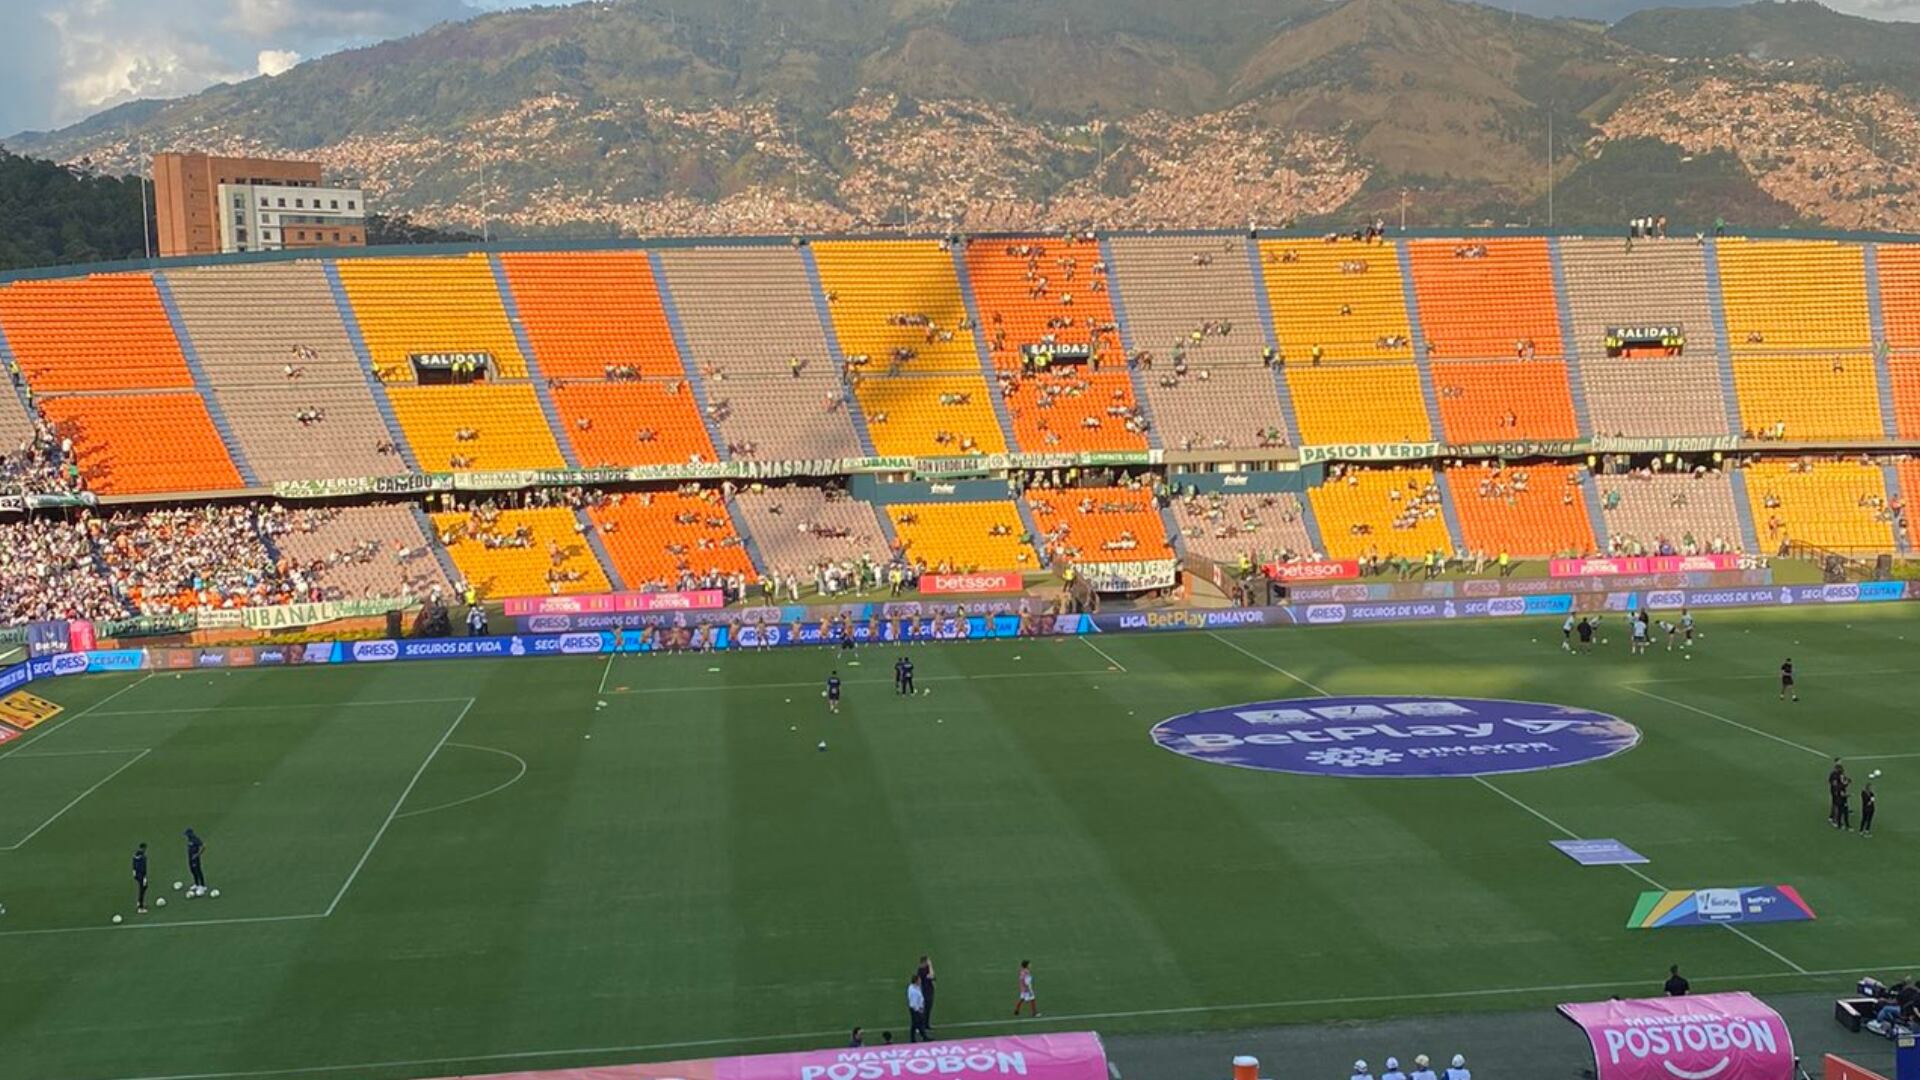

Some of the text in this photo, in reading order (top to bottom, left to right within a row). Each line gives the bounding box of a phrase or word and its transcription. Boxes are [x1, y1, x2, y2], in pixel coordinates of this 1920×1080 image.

[1303, 444, 1436, 460] PASION VERDE
[1277, 564, 1344, 577] betsson
[935, 575, 1006, 589] betsson
[1691, 593, 1734, 604] SEGUROS
[1736, 592, 1749, 601] DE
[1751, 591, 1773, 600] VIDA
[1311, 605, 1436, 619] ARESS SEGUROS DE VIDA
[625, 615, 640, 625] DE
[1119, 611, 1264, 628] LIGA BetPlay DIMAYOR
[357, 641, 502, 656] ARESS SEGUROS DE VIDA
[562, 636, 600, 649] ARESS
[1185, 722, 1494, 747] BetPlay
[837, 1045, 967, 1063] MANZANA
